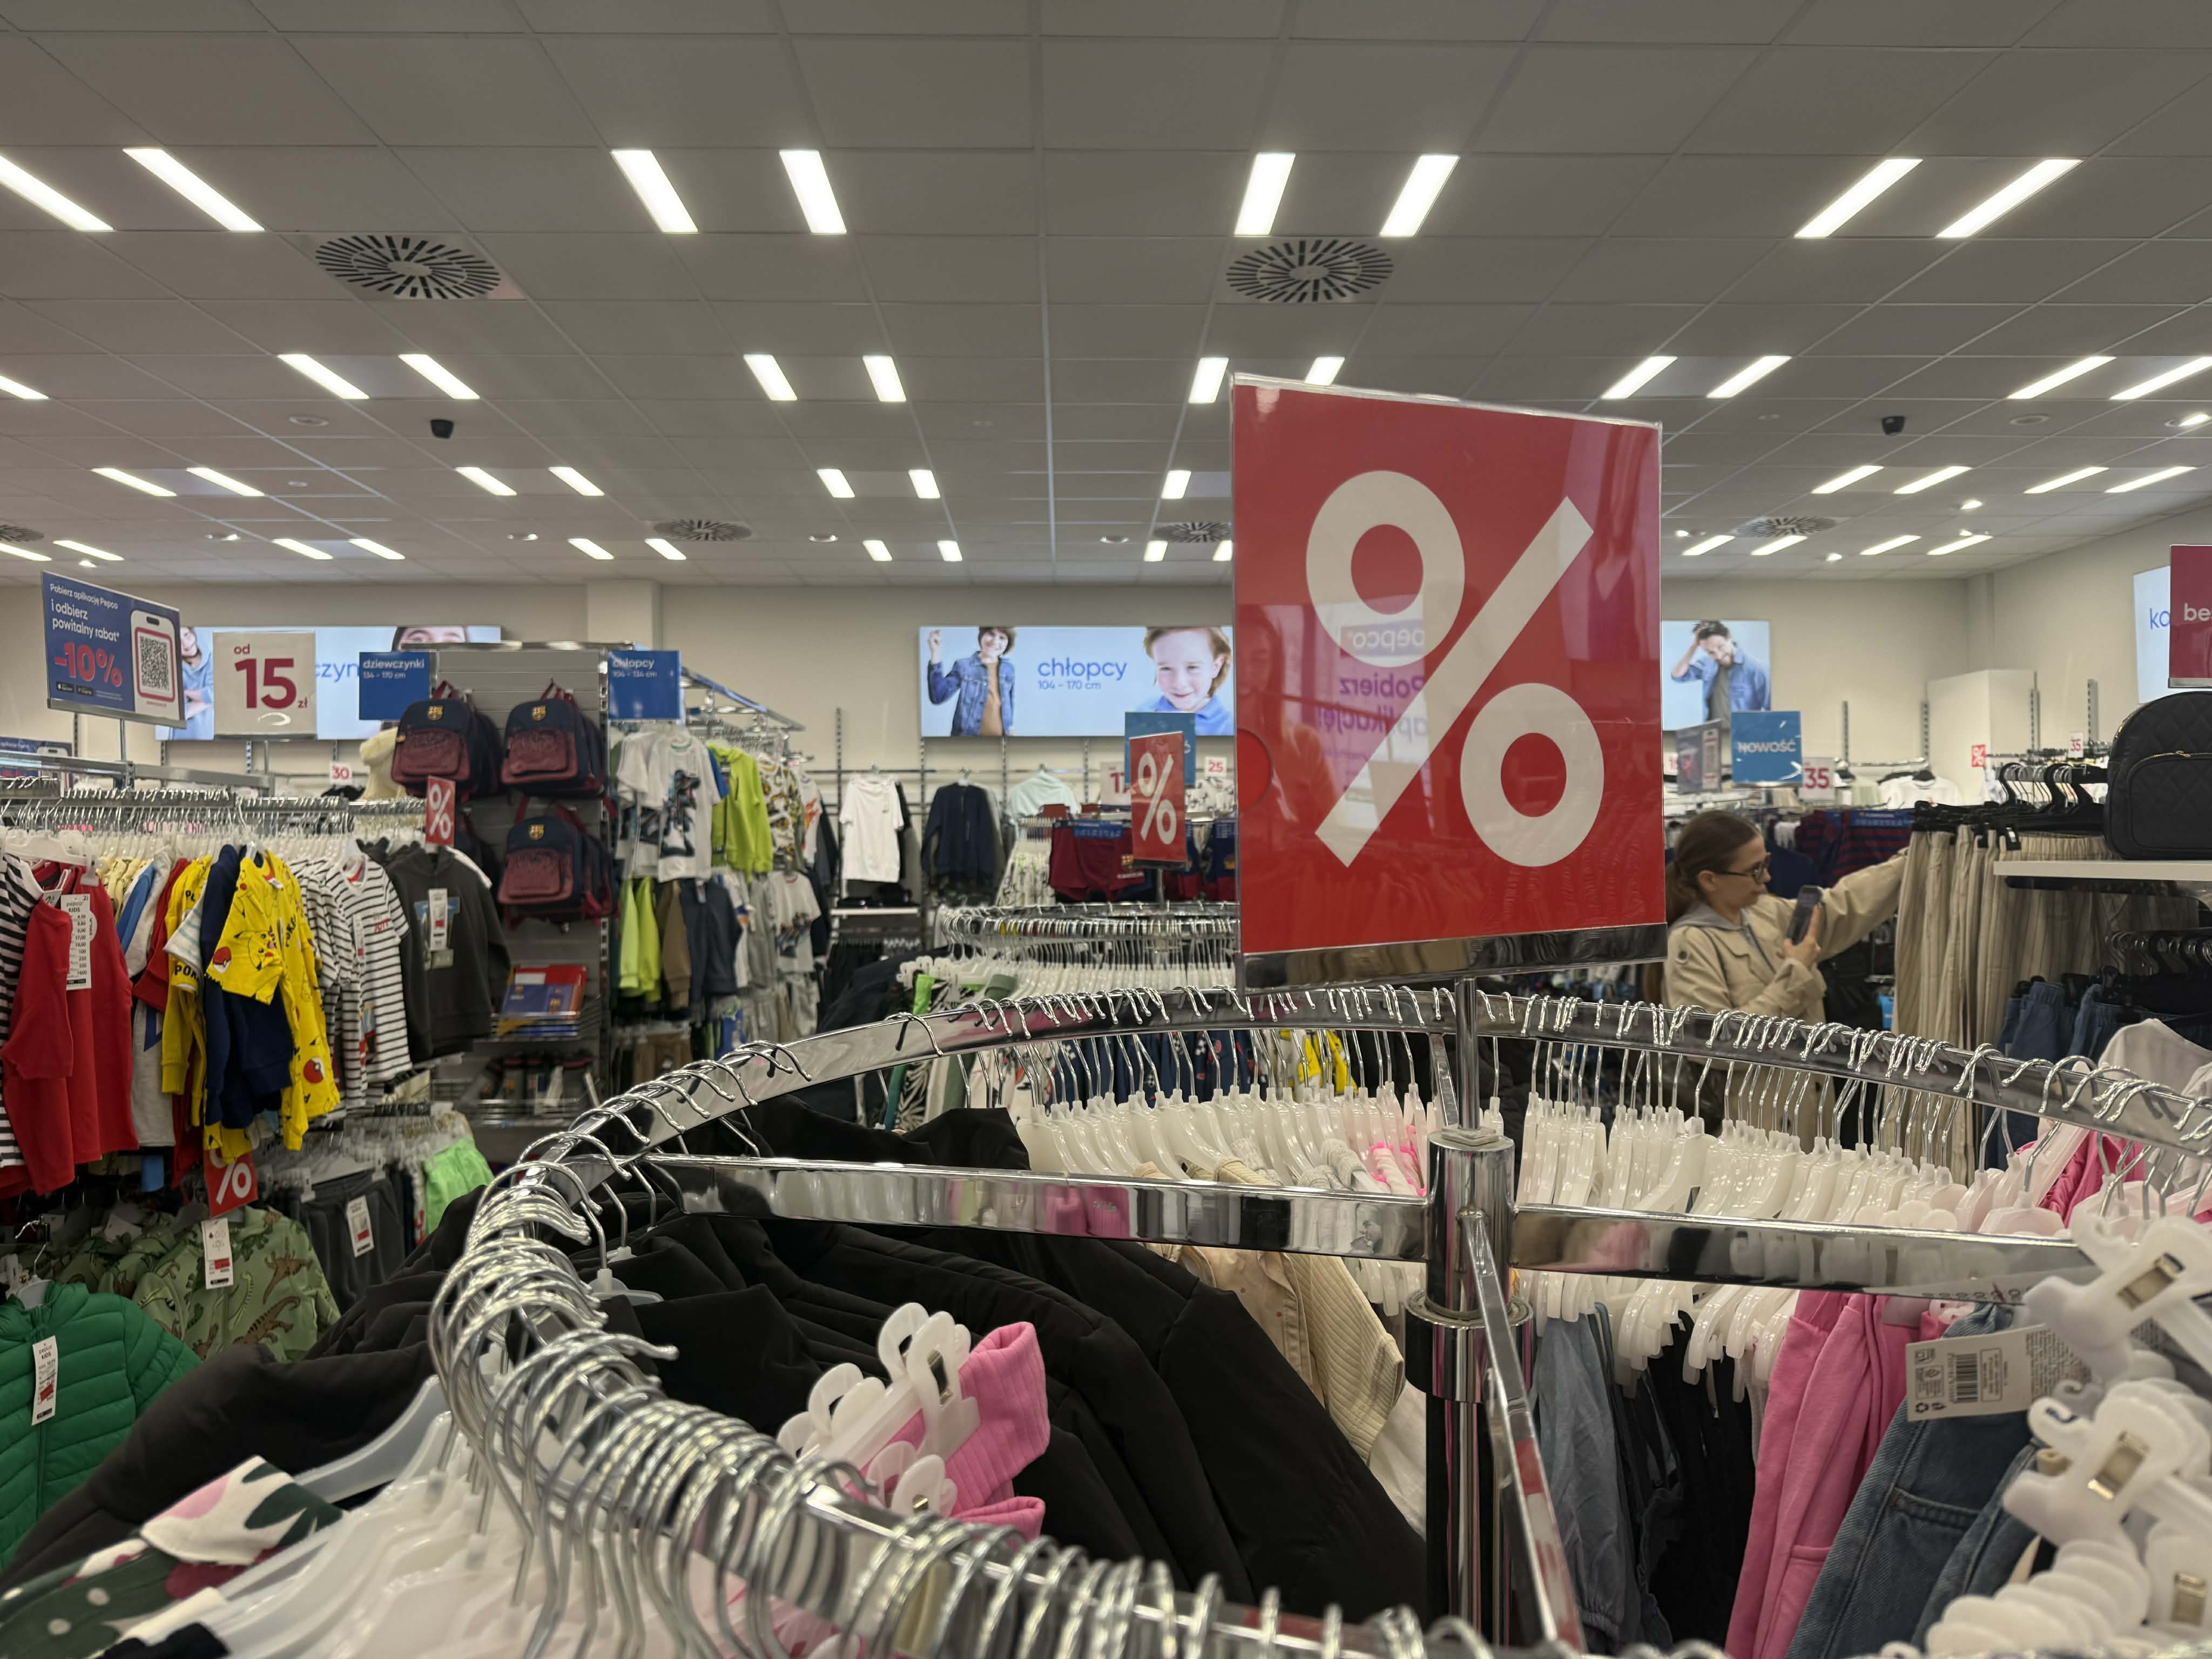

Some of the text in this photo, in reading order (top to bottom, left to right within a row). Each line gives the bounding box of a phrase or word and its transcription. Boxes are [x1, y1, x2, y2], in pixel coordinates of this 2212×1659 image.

[50, 583, 73, 597] Pobierz
[100, 598, 118, 610] Pepco
[51, 599, 89, 620] i odbierz
[52, 617, 94, 639] powitalny
[234, 644, 251, 655] od
[54, 642, 122, 687] -10%
[363, 658, 424, 670] dziewczynki
[1037, 657, 1127, 681] chłopcy
[234, 658, 307, 709] 15 zł
[1037, 680, 1055, 690] 104
[1067, 680, 1082, 690] 170
[1737, 739, 1796, 753] NOWOŚĆ
[332, 766, 349, 779] 30
[1209, 760, 1223, 772] 25
[1804, 767, 1830, 789] 35
